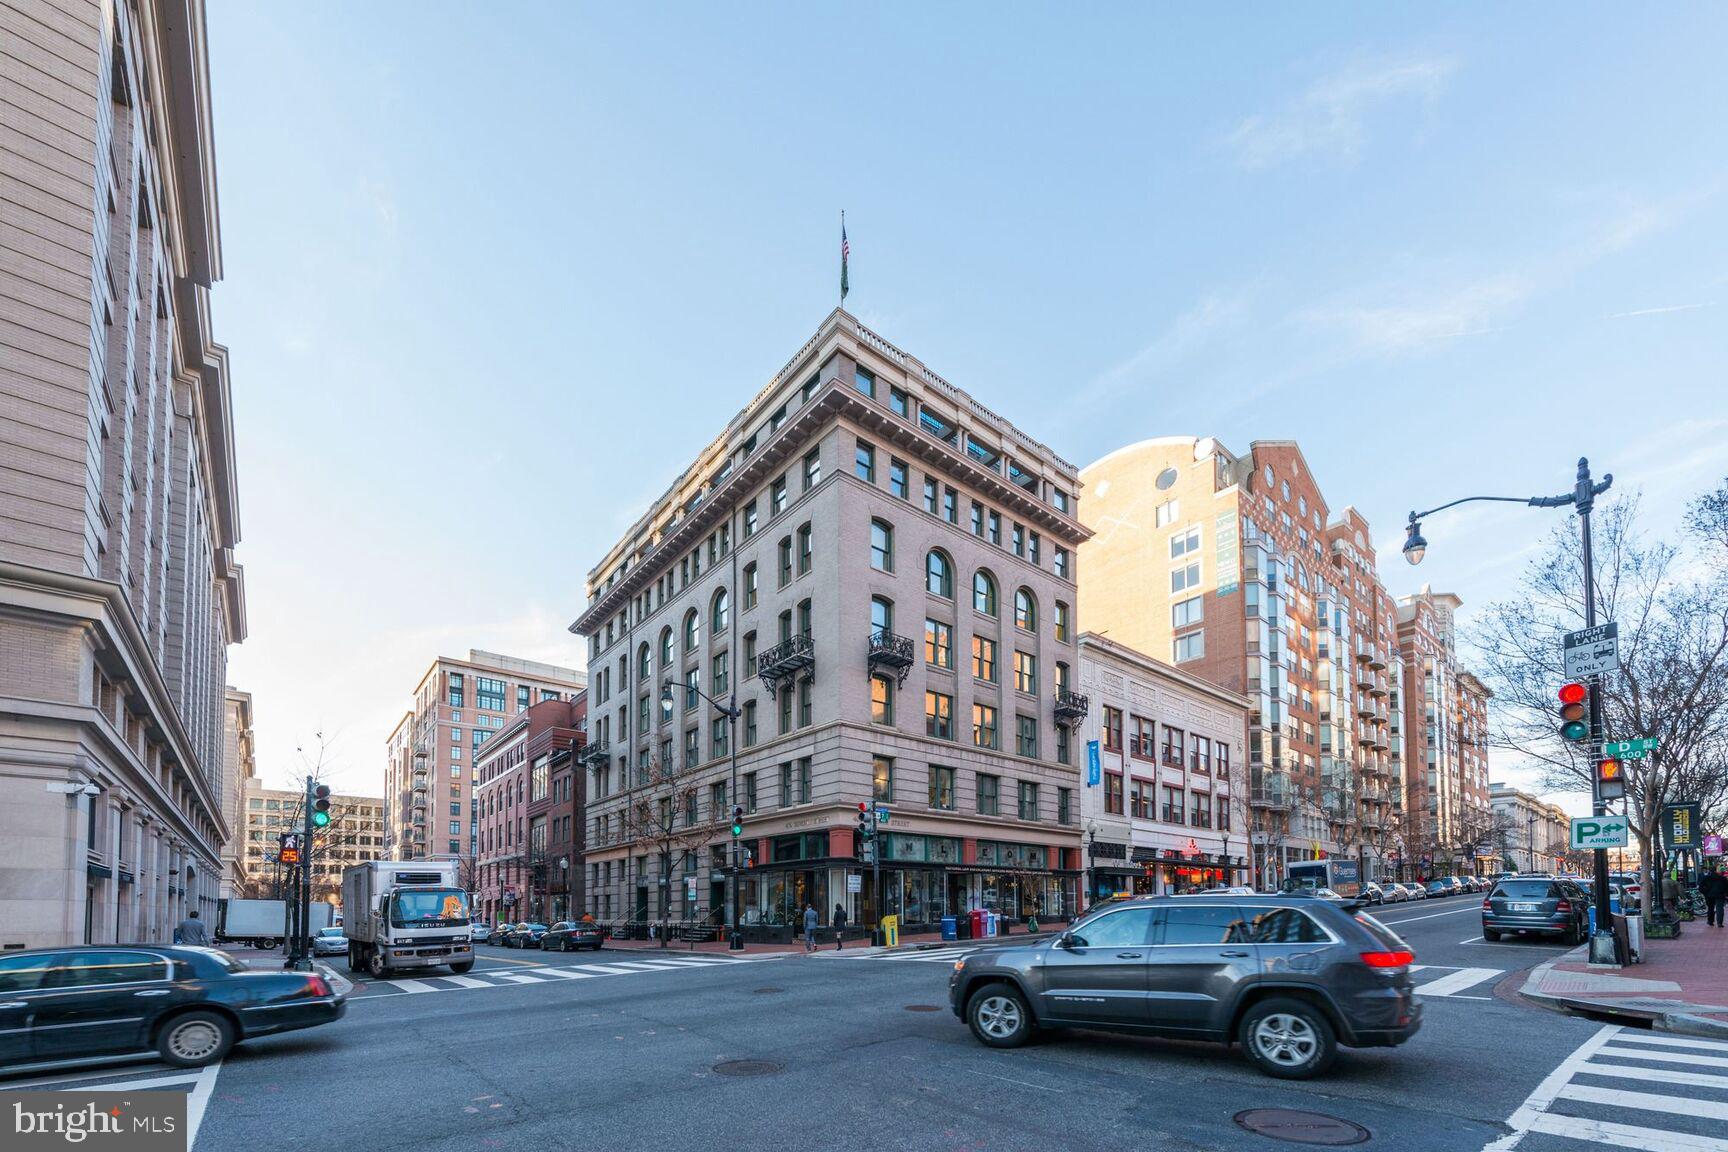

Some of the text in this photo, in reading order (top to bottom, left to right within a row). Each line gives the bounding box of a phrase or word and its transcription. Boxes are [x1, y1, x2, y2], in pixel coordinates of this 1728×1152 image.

[1574, 626, 1607, 640] RIGHT
[1575, 634, 1605, 646] LANE
[1576, 661, 1606, 672] ONLY
[1619, 742, 1630, 752] D
[1673, 809, 1683, 844] WOOLLY
[283, 851, 296, 861] 25
